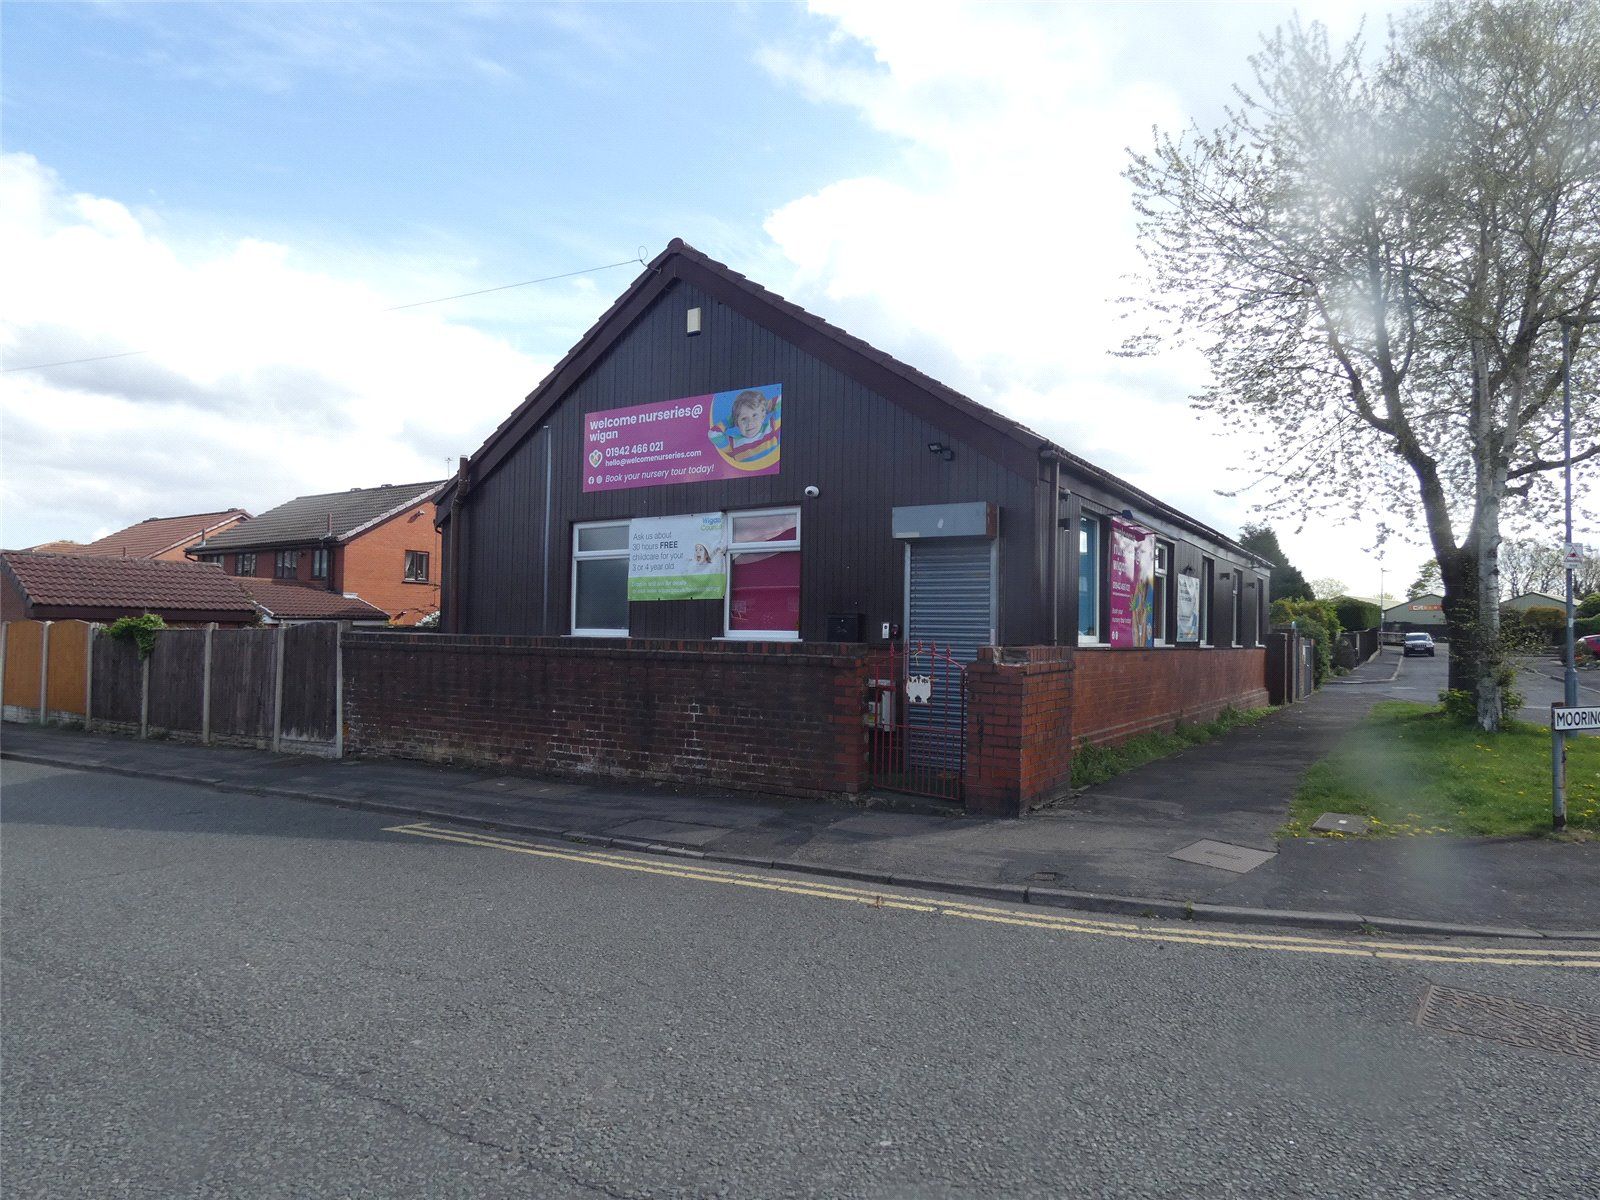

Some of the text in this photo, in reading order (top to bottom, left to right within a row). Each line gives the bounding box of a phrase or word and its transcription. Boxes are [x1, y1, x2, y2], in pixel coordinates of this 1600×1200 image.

[590, 405, 702, 430] welcome nurseries@
[590, 430, 618, 443] wigan
[606, 441, 664, 457] 01942 466 021
[606, 451, 701, 466] hello@welcomenurseries.com
[623, 473, 640, 483] your
[642, 470, 669, 479] nursery
[671, 467, 686, 476] tour
[689, 464, 714, 475] today!
[642, 542, 658, 550] hours
[660, 541, 678, 549] FREE
[670, 552, 684, 561] your
[651, 564, 663, 572] year
[1556, 711, 1600, 727] MOORIN
